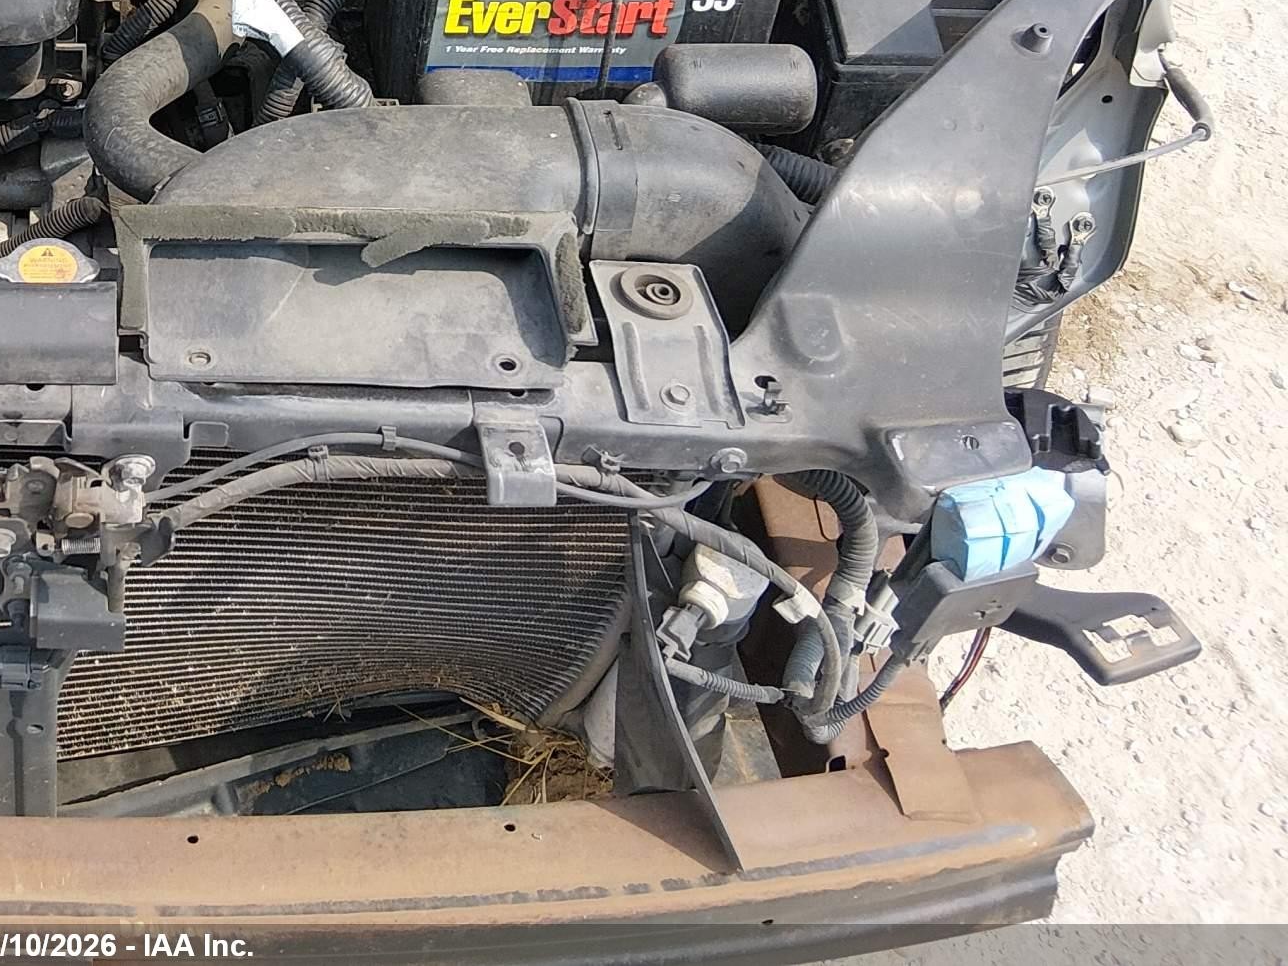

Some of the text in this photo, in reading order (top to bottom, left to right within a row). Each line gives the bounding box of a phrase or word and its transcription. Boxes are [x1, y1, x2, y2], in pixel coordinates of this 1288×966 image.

[445, 45, 451, 53] 1
[455, 45, 479, 54] Year
[480, 45, 504, 54] Free
[506, 45, 577, 55] Replacement
